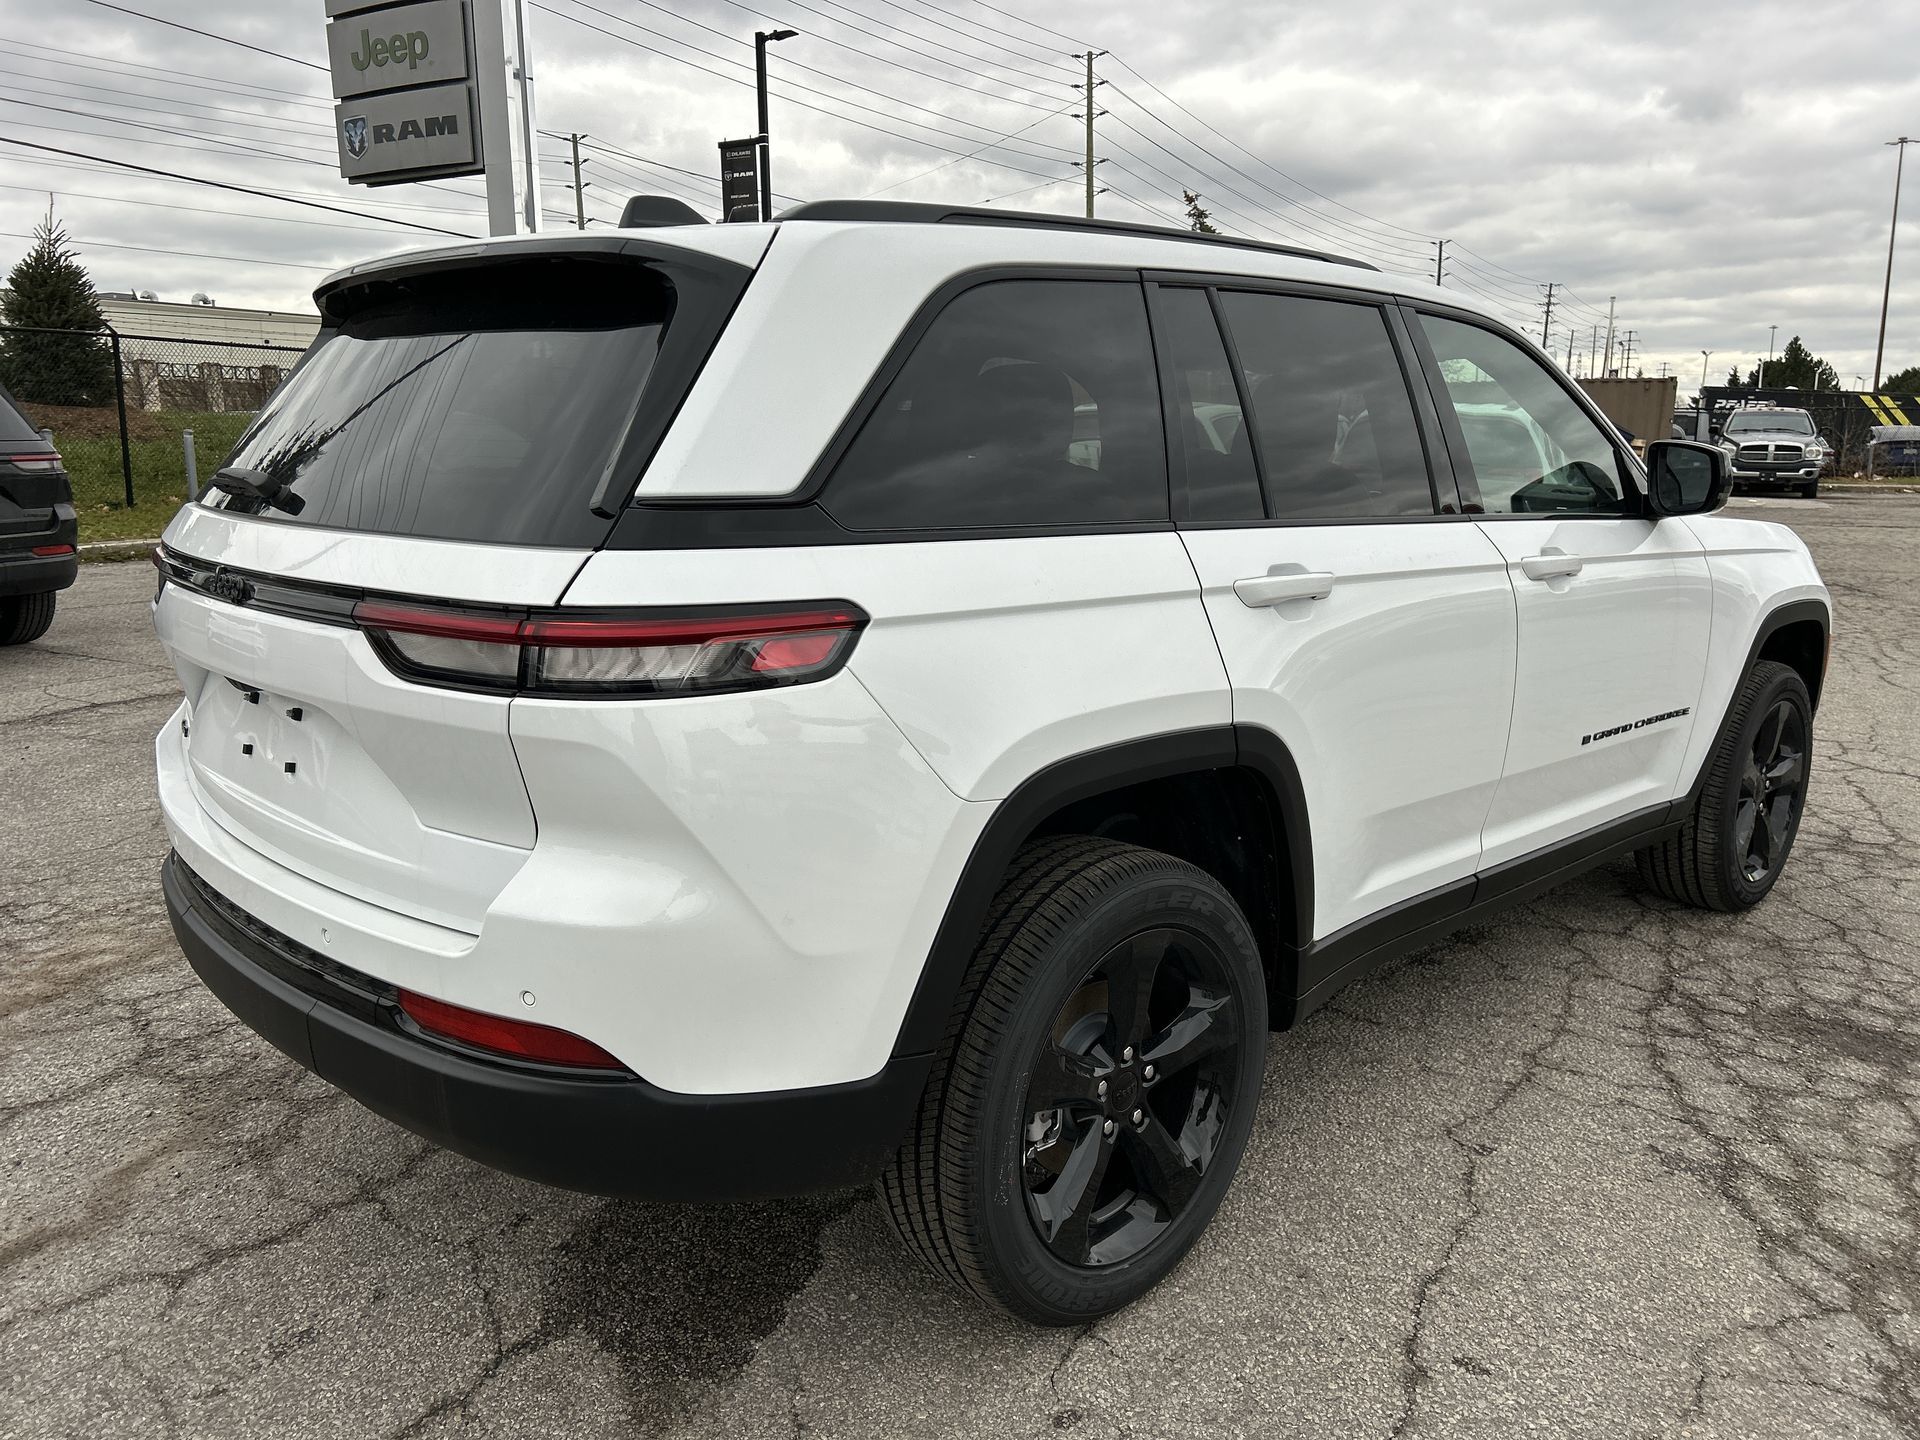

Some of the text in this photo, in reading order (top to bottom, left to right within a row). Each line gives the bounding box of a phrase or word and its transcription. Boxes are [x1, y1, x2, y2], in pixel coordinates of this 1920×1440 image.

[351, 28, 430, 72] Jeep
[372, 114, 459, 145] RAM
[1593, 706, 1691, 741] GRAND CHEROKEE
